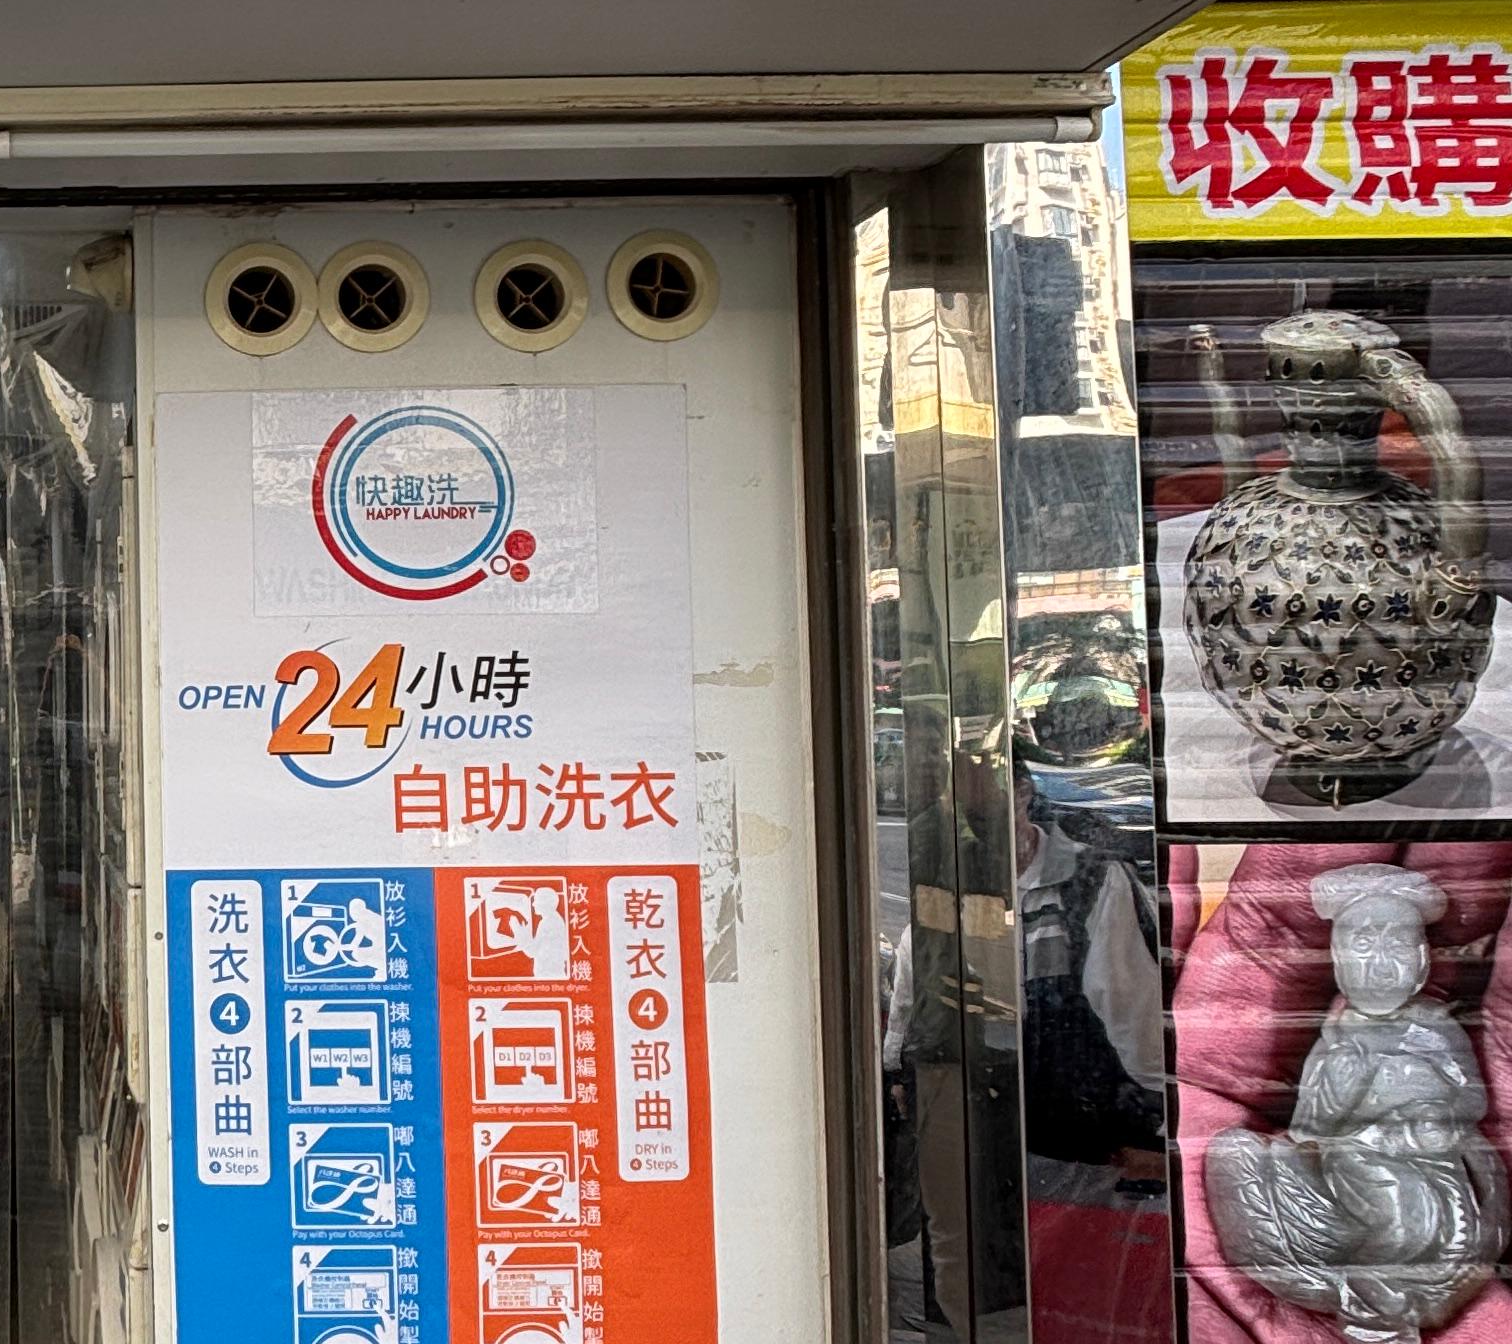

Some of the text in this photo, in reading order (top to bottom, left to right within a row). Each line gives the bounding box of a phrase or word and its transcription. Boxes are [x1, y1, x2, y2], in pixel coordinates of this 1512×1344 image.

[1165, 53, 1512, 209] 收購
[356, 473, 494, 506] 快趣洗
[366, 506, 477, 520] HAPPY LAUNDRY
[267, 642, 531, 755] 24 小時
[178, 684, 533, 740] OPEN HOURS
[392, 761, 678, 834] 自助洗衣
[287, 886, 298, 901] 1
[471, 883, 481, 898] 1
[385, 880, 409, 979] 放衫入機
[568, 883, 593, 982] 放衫入機
[299, 984, 317, 993] your
[368, 983, 381, 991] the
[291, 1008, 303, 1023] 2
[475, 1007, 486, 1022] 2
[313, 1052, 369, 1062] W1 W2 W3
[389, 1002, 414, 1101] 揀機編號
[499, 1051, 552, 1061] D1 D2 D3
[574, 1004, 598, 1104] 揀機編號
[296, 1131, 307, 1147] 3
[481, 1130, 491, 1146] 3
[208, 1147, 258, 1158] WASH in
[635, 1143, 672, 1155] DRY in
[225, 1162, 259, 1175] Steps
[645, 1158, 678, 1170] Steps
[394, 1126, 417, 1225] 嘟八達通
[579, 1128, 601, 1226] 嘟八達通
[293, 1230, 308, 1240] Pay
[309, 1230, 327, 1238] with
[329, 1231, 346, 1240] your
[348, 1230, 382, 1239] Octopus
[478, 1230, 493, 1240] Pay
[300, 1252, 311, 1268] 4
[485, 1250, 496, 1266] 4
